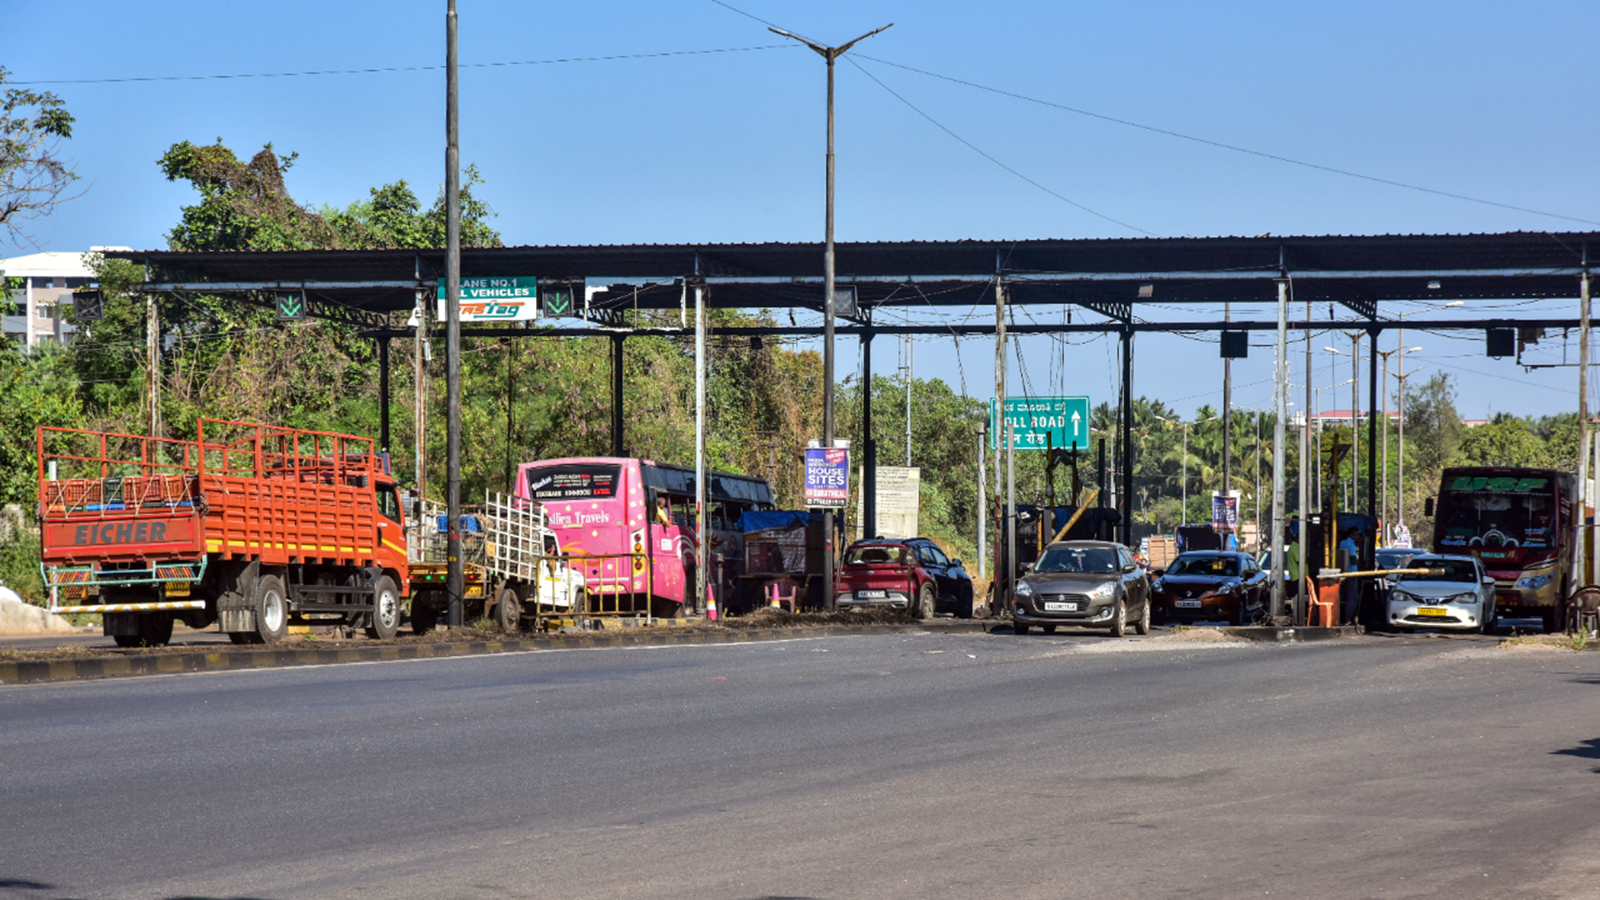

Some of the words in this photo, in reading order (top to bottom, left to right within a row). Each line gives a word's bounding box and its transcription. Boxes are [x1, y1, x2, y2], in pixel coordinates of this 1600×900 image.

[460, 279, 487, 288] ANE
[491, 278, 517, 287] NO.1
[470, 288, 530, 297] VEHICLES
[1004, 416, 1027, 428] OLL
[1031, 416, 1065, 428] ROAD
[808, 467, 845, 476] HOUSE
[808, 475, 845, 485] SITES
[1452, 476, 1548, 491] USF
[575, 510, 609, 524] Travels
[75, 521, 167, 544] EICHER
